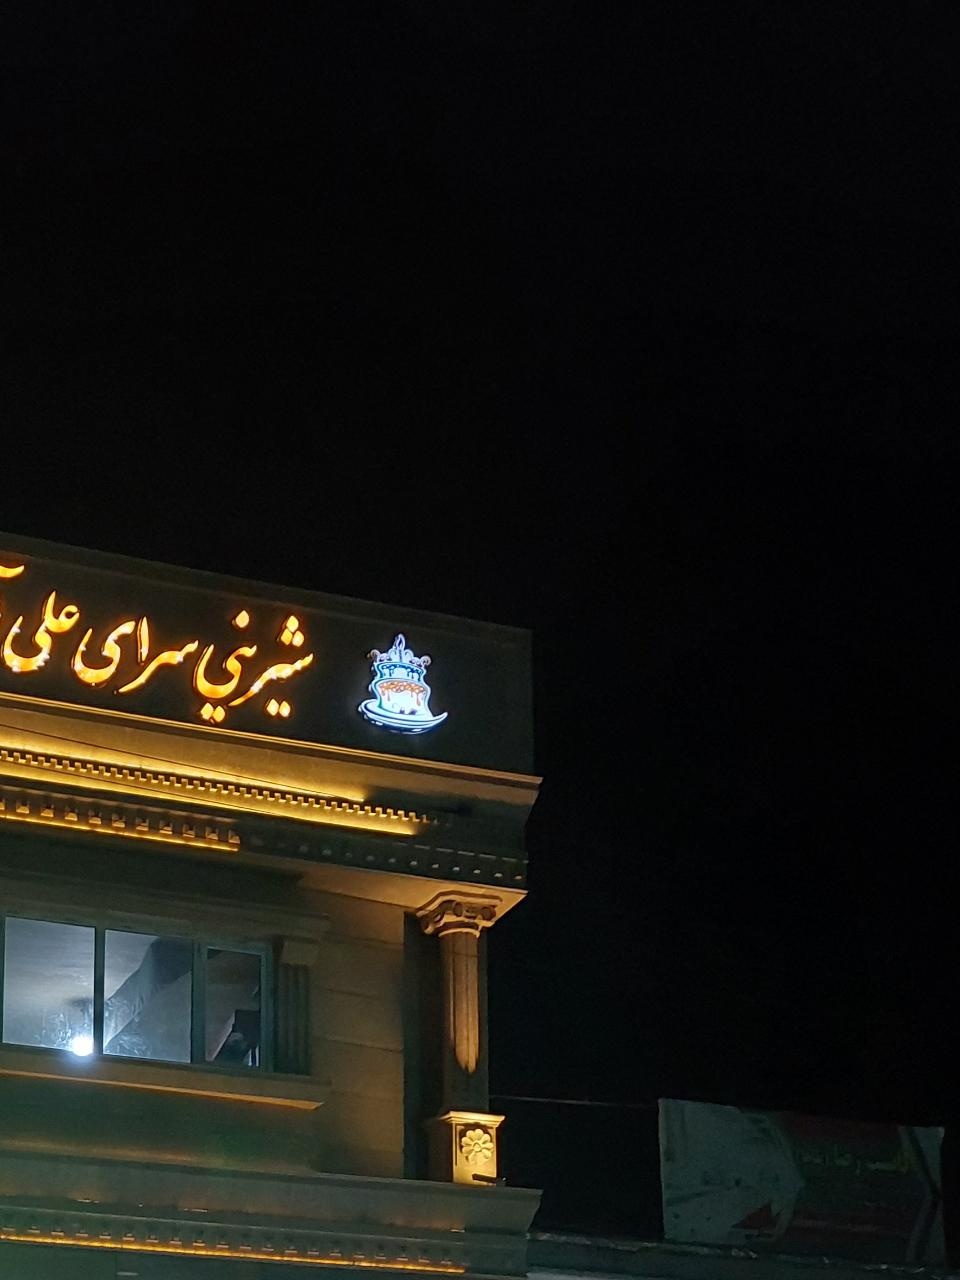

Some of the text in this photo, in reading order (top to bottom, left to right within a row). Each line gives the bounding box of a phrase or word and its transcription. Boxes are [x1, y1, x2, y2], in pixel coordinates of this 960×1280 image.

[1, 590, 80, 673] علی
[71, 616, 199, 694] سرای
[193, 610, 314, 723] شیرینی
